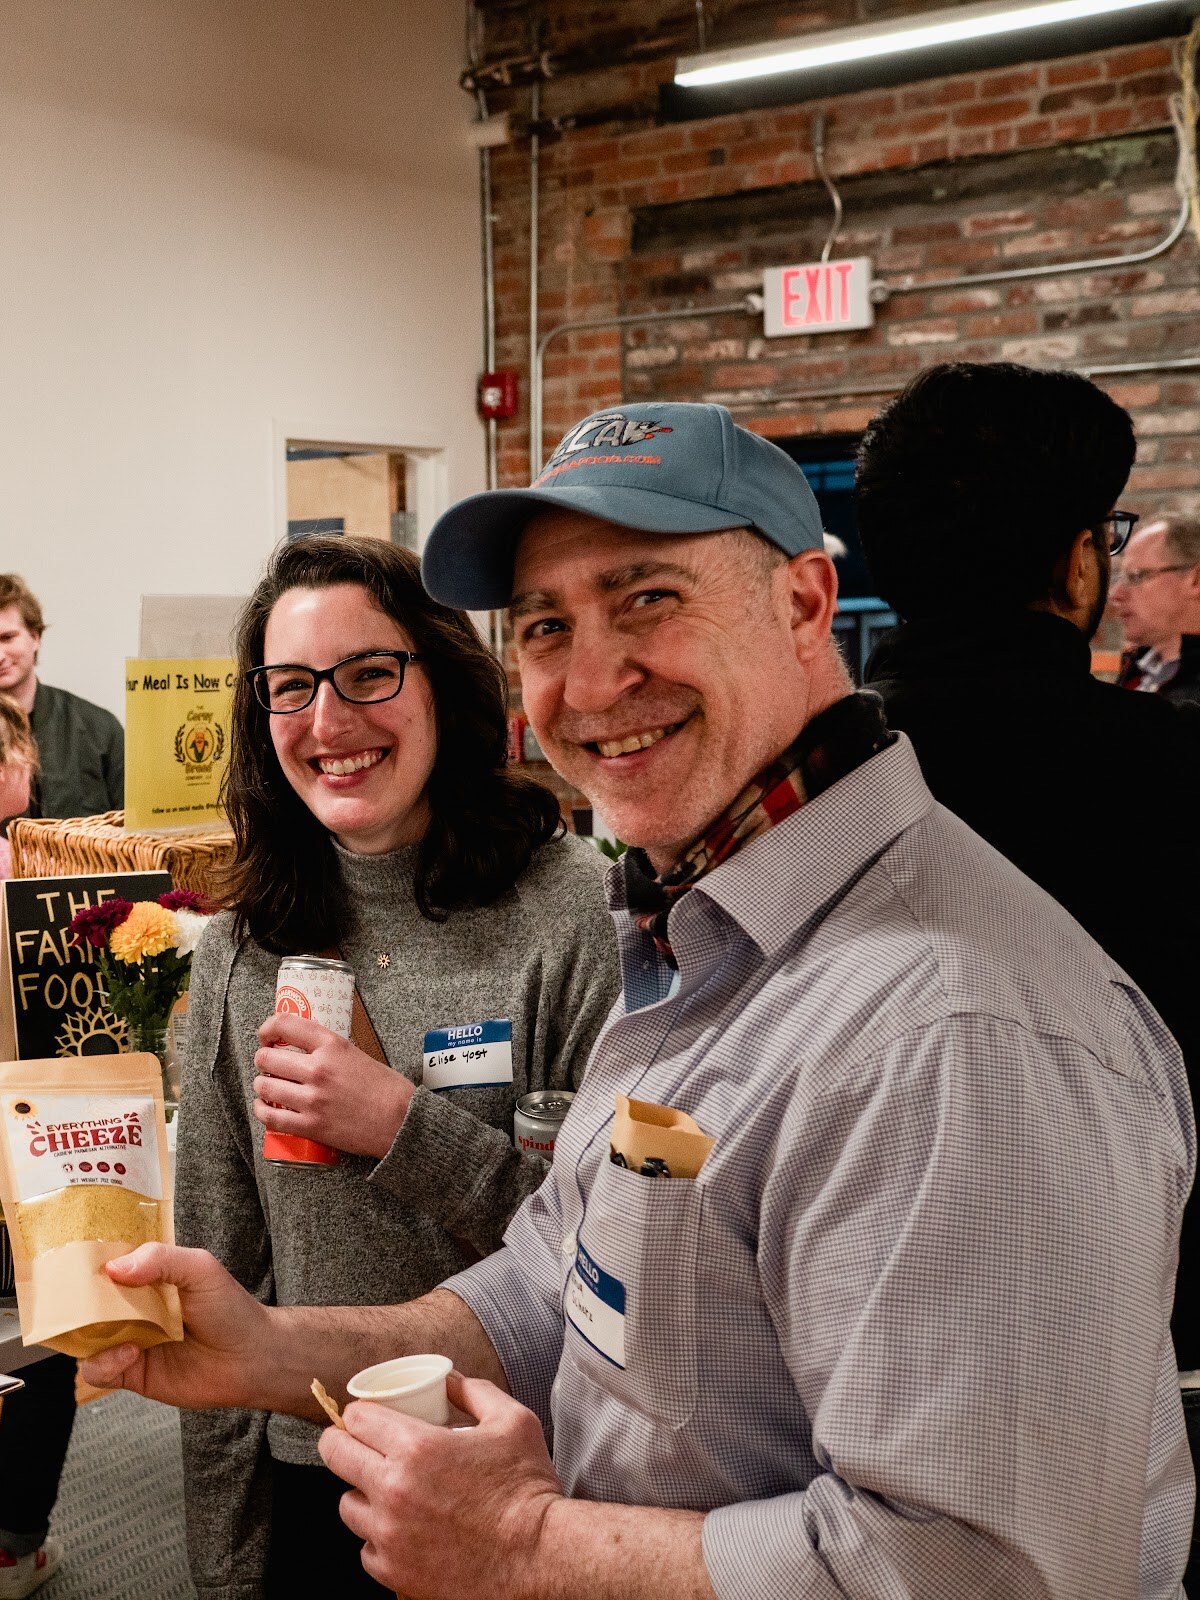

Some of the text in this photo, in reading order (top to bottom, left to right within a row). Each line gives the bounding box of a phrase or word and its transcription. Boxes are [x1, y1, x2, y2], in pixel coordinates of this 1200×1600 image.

[783, 265, 852, 326] EXIT
[125, 678, 138, 691] ur
[143, 674, 170, 690] Meal
[176, 674, 188, 689] Is
[194, 674, 219, 688] Now
[448, 1026, 483, 1040] HELLO
[429, 1052, 456, 1067] Elise
[46, 1118, 122, 1132] EVERYTHING
[30, 1125, 142, 1157] CHEEZE
[519, 1135, 555, 1152] spind
